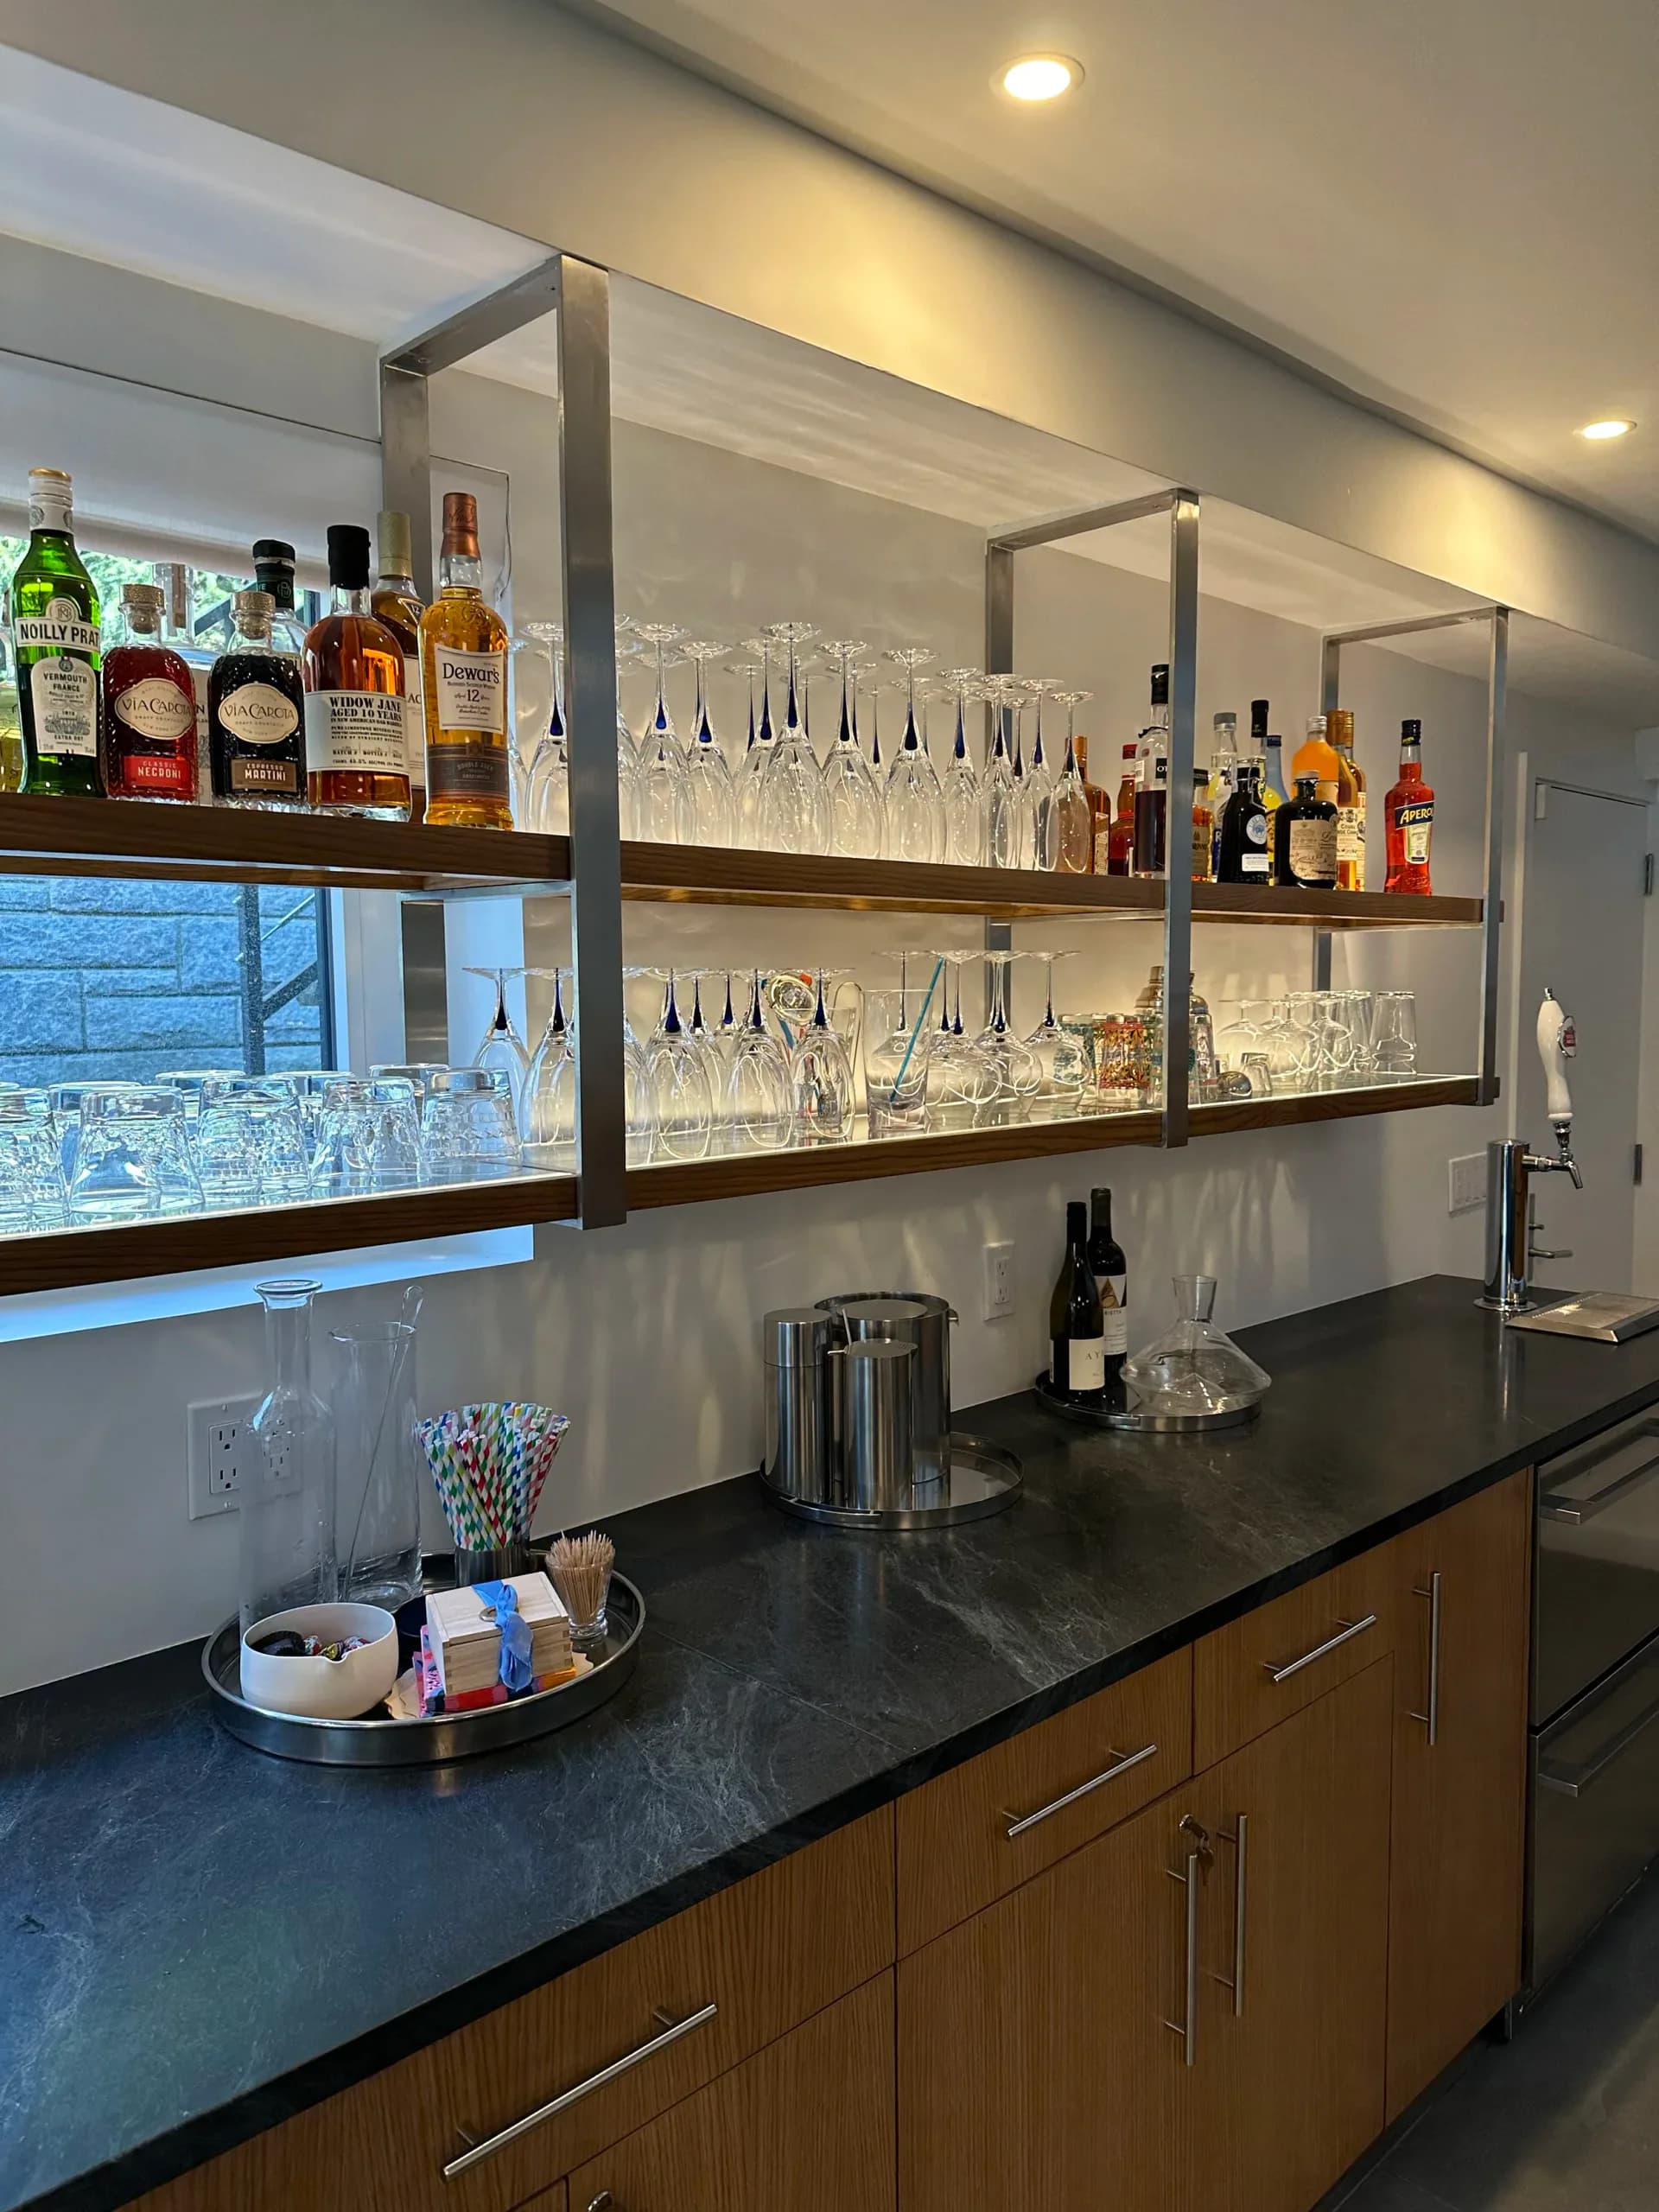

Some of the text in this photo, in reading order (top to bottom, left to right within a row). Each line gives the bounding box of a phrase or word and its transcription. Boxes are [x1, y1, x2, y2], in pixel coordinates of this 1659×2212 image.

[20, 624, 99, 647] NOILLY PRAT
[43, 672, 87, 684] VERMOUTH
[442, 663, 499, 683] Dewar's
[53, 683, 80, 692] FRANCE
[467, 689, 480, 702] 12
[224, 702, 295, 720] VIA CAROTA
[329, 696, 402, 713] WIDOW JANE
[330, 708, 403, 722] AGED 10 YEARS
[137, 767, 181, 779] NEGRONI
[245, 769, 286, 781] MARTINI
